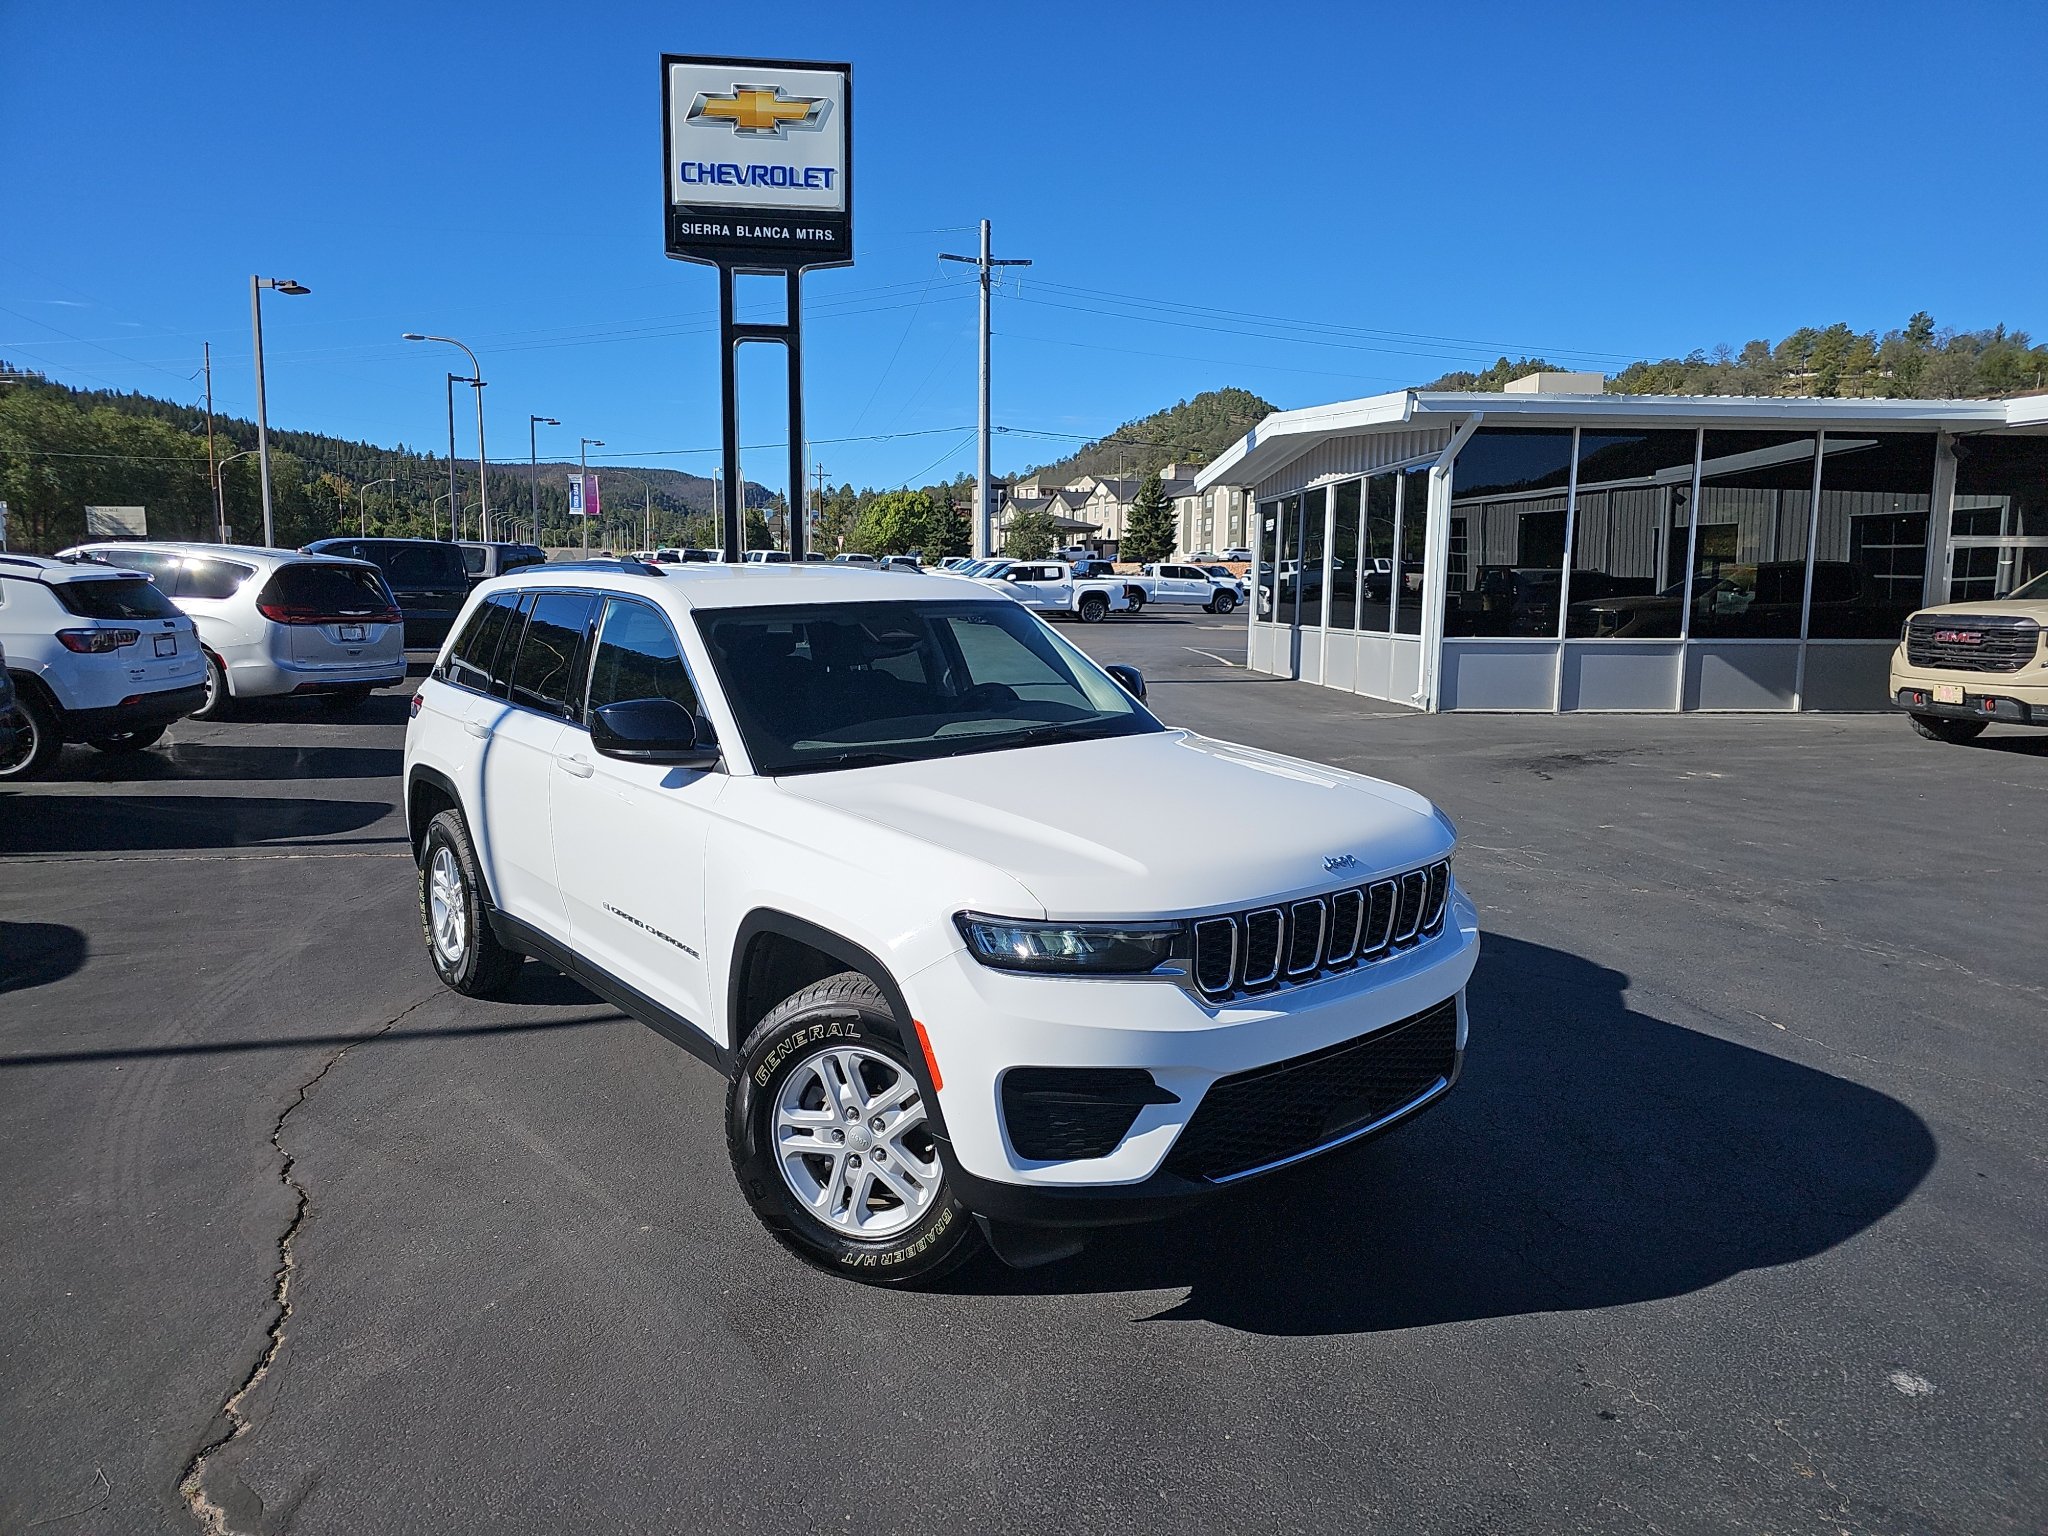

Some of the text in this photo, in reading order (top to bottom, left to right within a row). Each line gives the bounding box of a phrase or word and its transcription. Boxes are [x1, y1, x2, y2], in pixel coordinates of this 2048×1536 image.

[681, 161, 835, 189] CHEVROLET
[681, 222, 835, 241] SIERRA BLANCA MTRS.
[1934, 630, 1983, 644] GMC
[755, 1022, 861, 1087] GENERAL
[841, 1207, 953, 1267] GRABBER H/T
